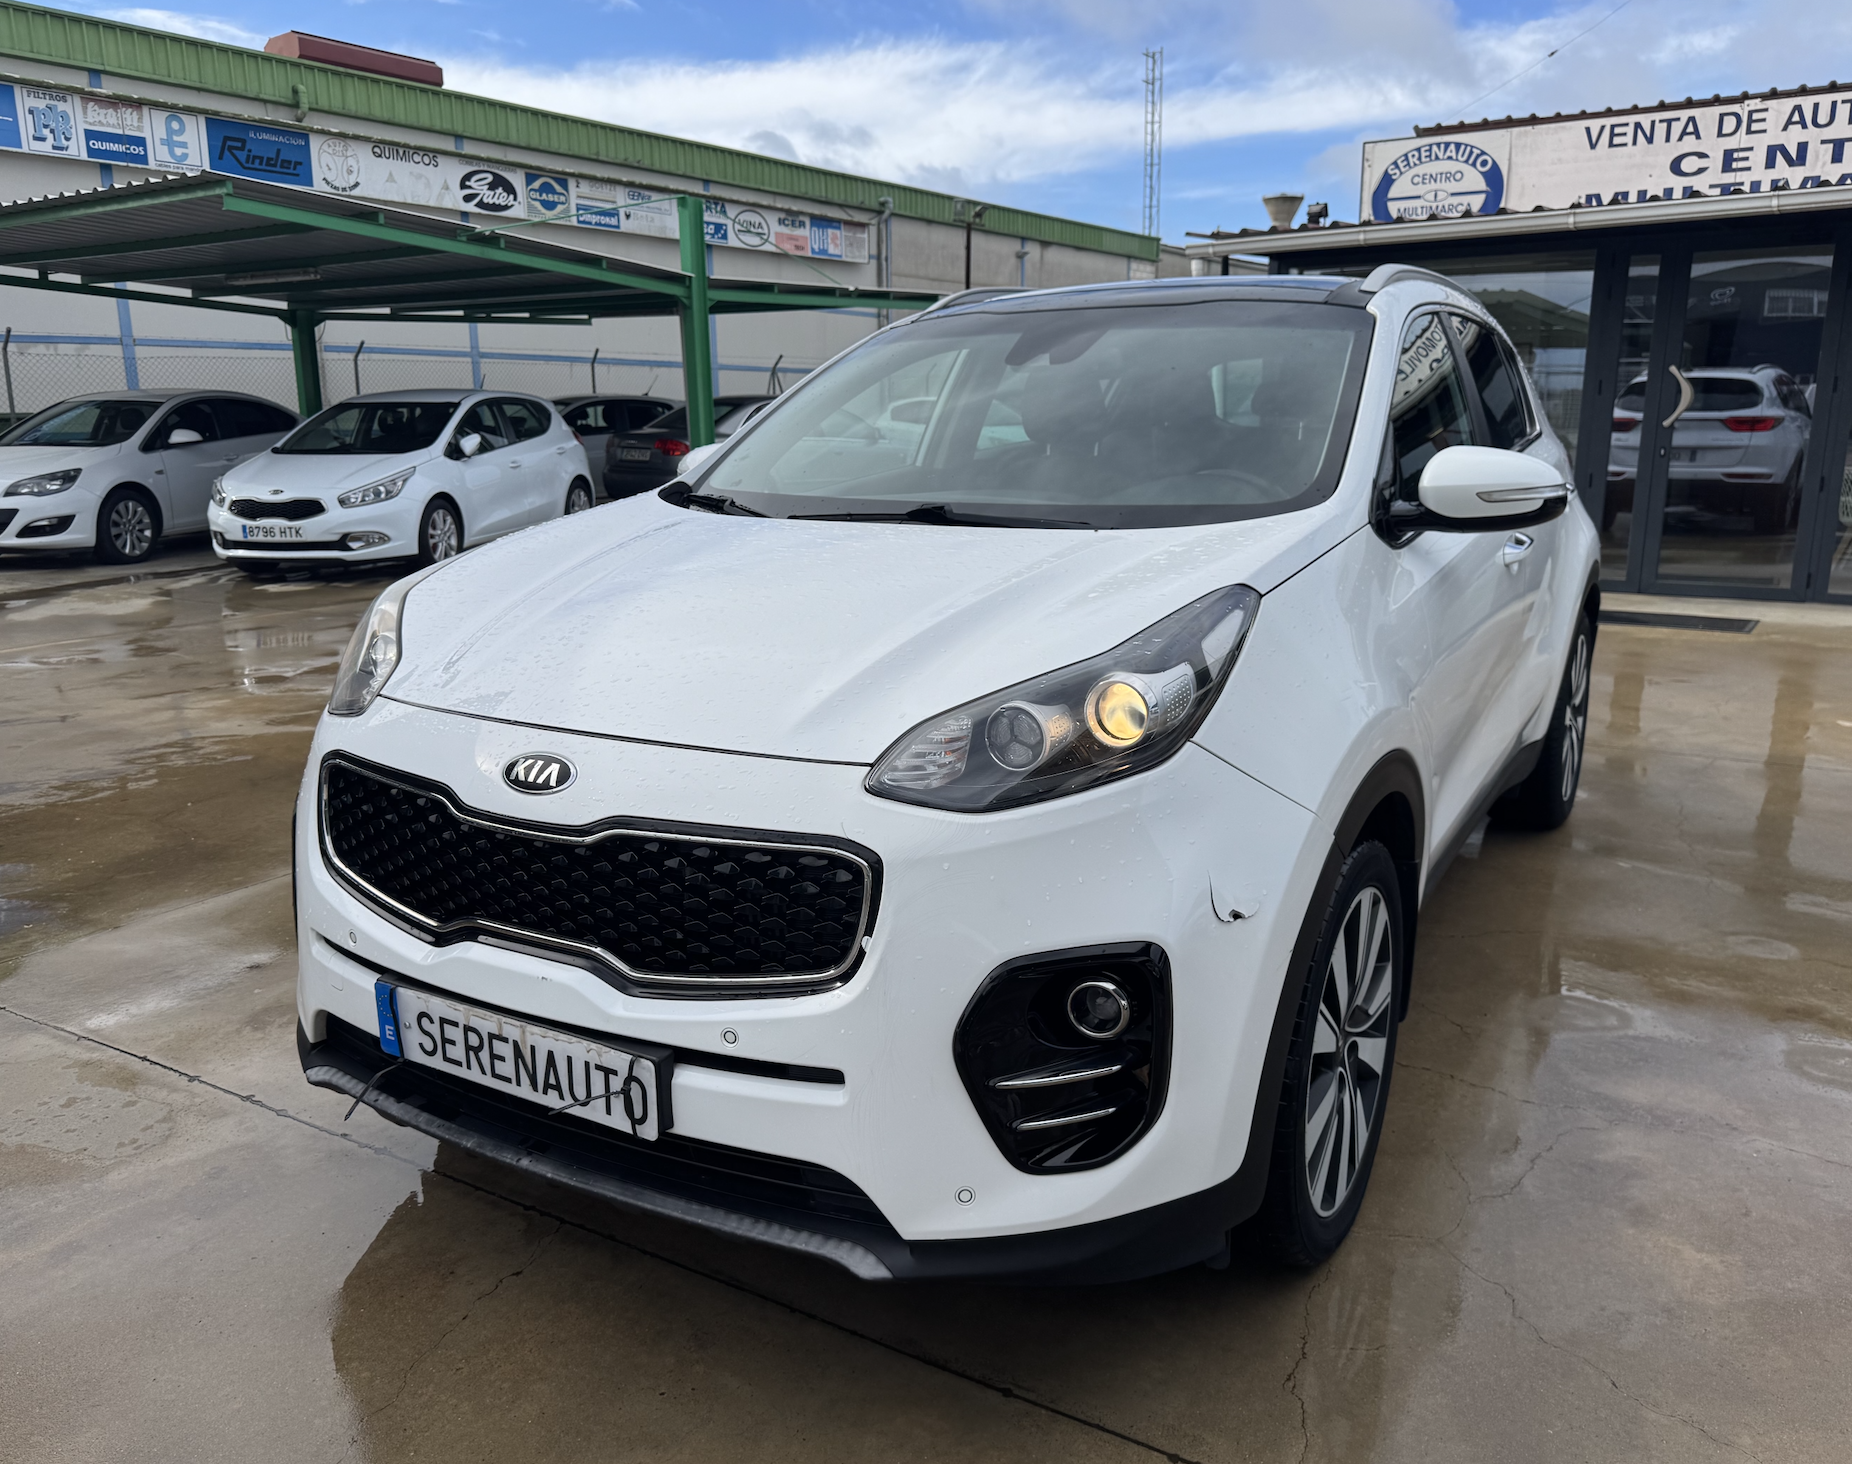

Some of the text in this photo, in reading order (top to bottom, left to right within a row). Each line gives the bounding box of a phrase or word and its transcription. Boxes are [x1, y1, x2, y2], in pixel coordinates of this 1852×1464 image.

[26, 90, 68, 103] FILTROS
[1584, 116, 1702, 151] VENTA
[1716, 107, 1769, 139] DE
[89, 139, 145, 155] QUIMICOS
[218, 135, 304, 177] Rinder
[371, 144, 439, 168] QUIMICOS
[1669, 137, 1852, 177] CENT
[1387, 143, 1493, 180] SERENAUTO
[461, 172, 518, 207] Gates
[1411, 170, 1464, 186] CENTRO
[778, 217, 806, 229] ICER
[811, 227, 828, 252] QH
[248, 526, 303, 538] 8796 HTK
[509, 758, 560, 787] KIA
[385, 1024, 395, 1041] E
[415, 1010, 648, 1126] SERENAUTO
